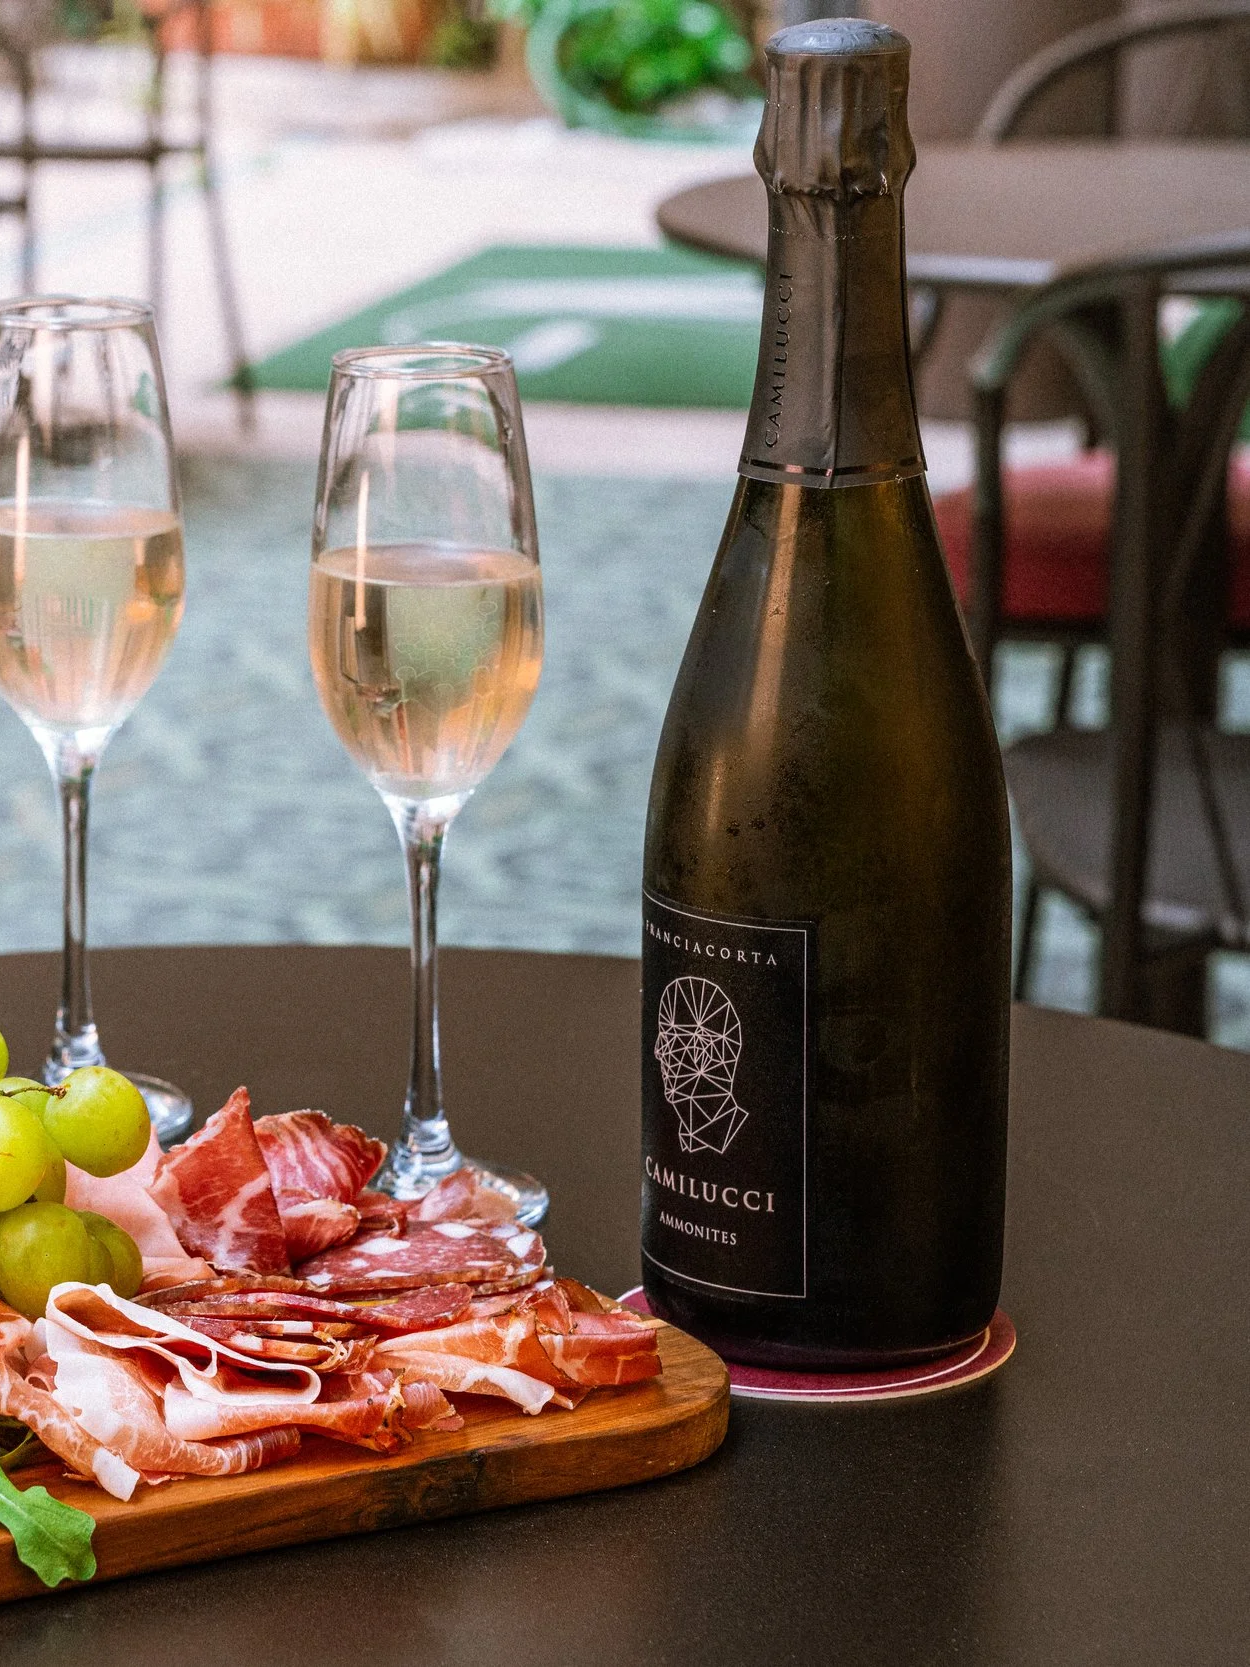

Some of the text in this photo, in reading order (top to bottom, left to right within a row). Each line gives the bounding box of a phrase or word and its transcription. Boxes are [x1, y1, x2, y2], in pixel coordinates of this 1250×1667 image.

[765, 273, 793, 448] CAMILUCCI
[645, 1156, 775, 1213] CAMILUCCI
[659, 1211, 737, 1246] AMMONITES
